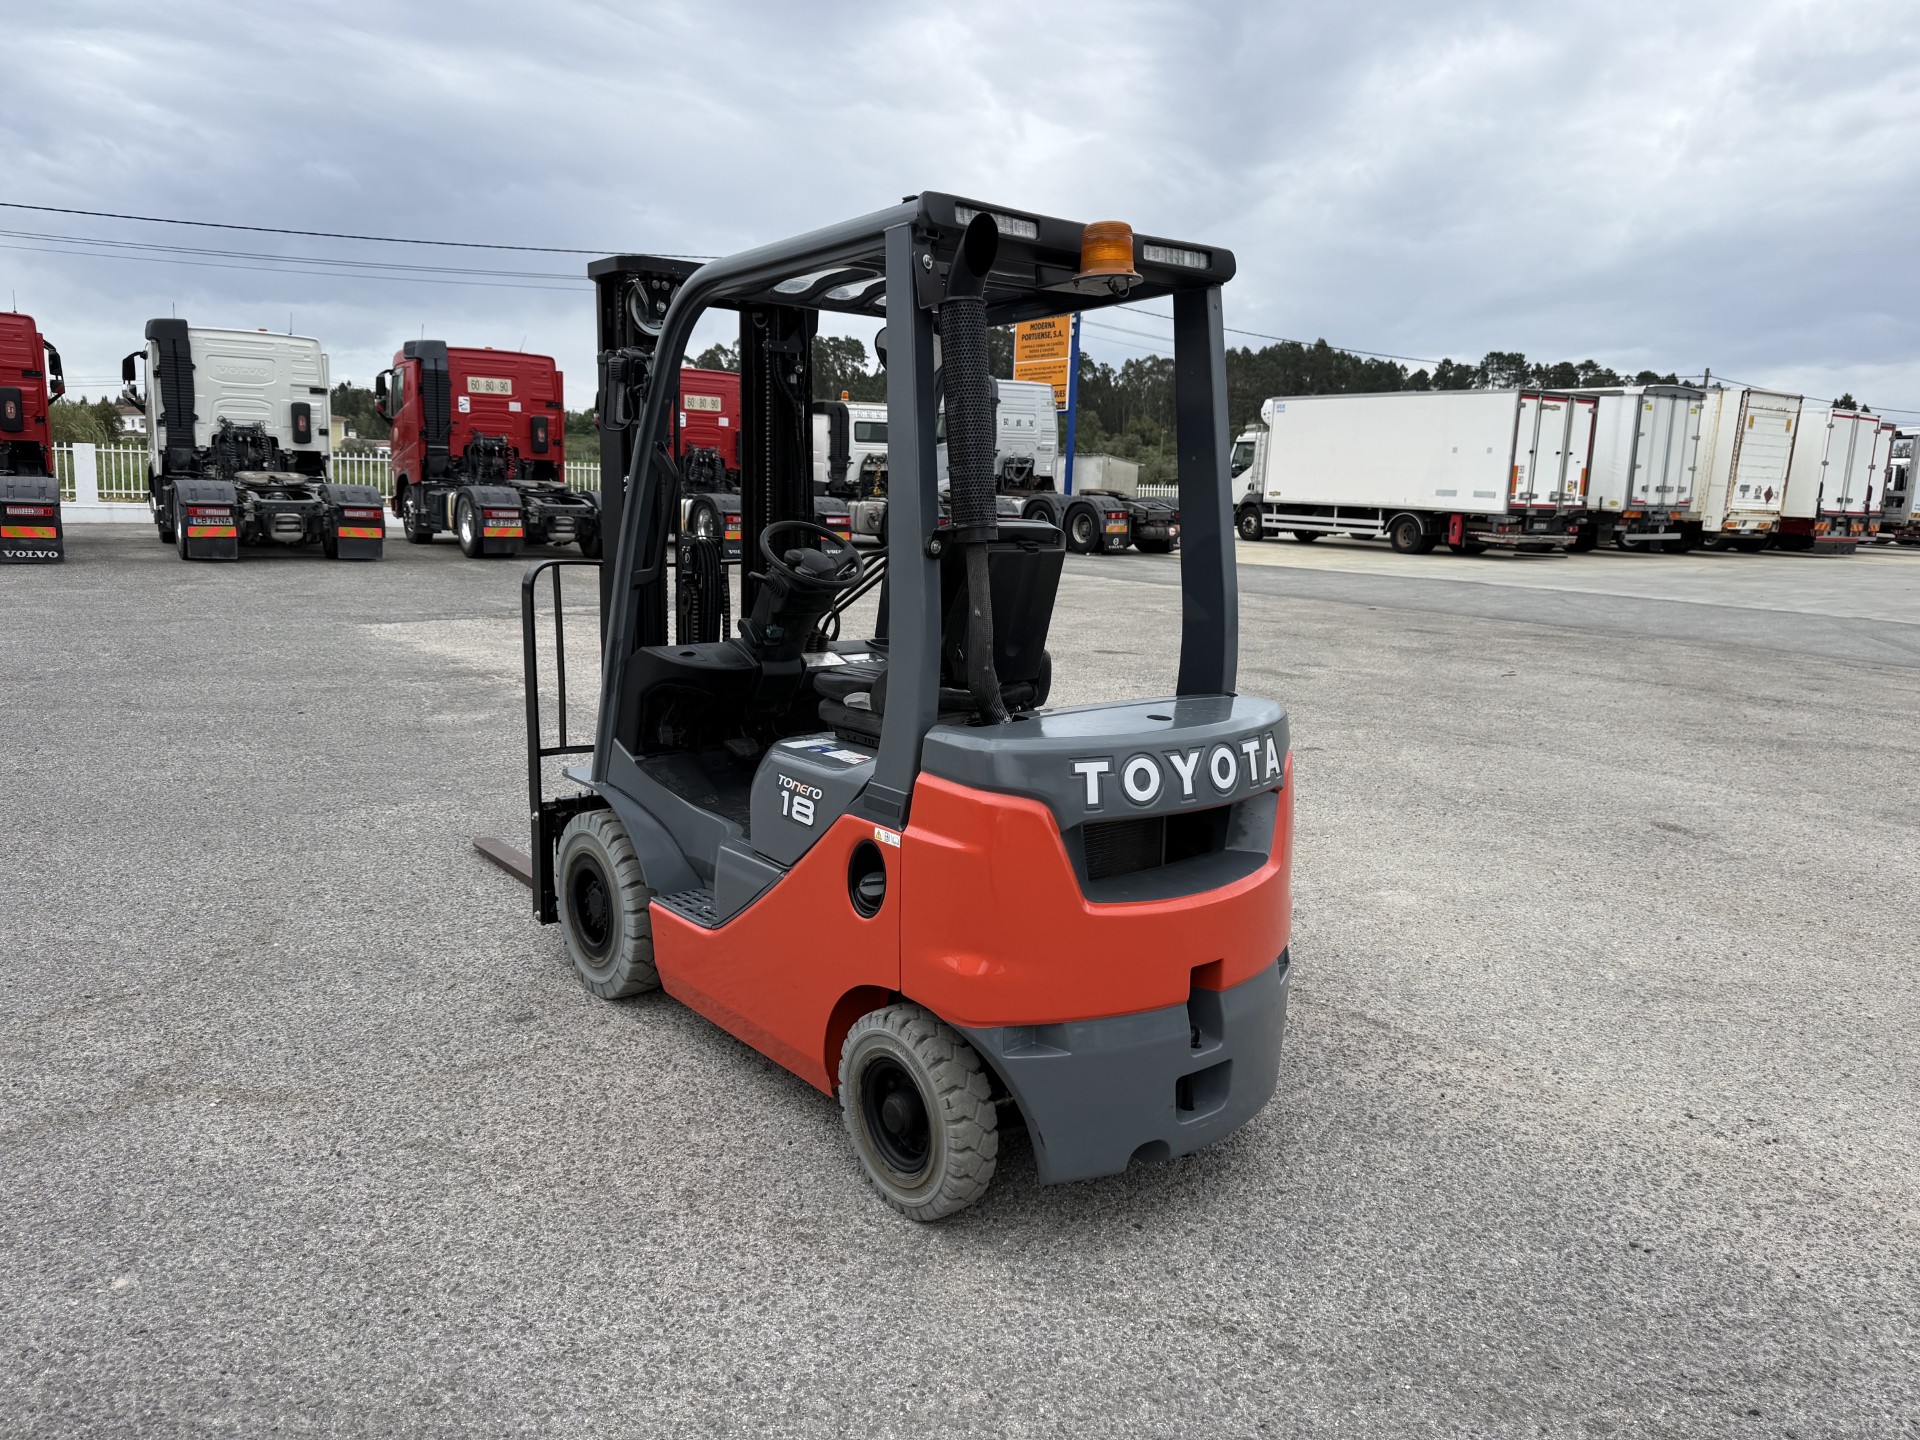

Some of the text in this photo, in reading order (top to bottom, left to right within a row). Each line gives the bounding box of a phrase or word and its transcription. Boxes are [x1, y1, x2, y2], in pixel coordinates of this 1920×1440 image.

[1030, 321, 1055, 331] MODERNA
[1022, 329, 1064, 341] PORTUENSE, S.A.
[215, 366, 268, 377] VOLVO
[471, 380, 508, 392] 60 80 90
[2, 550, 59, 558] VOLVO
[1073, 737, 1282, 806] TOYOTA
[780, 790, 815, 827] 18
